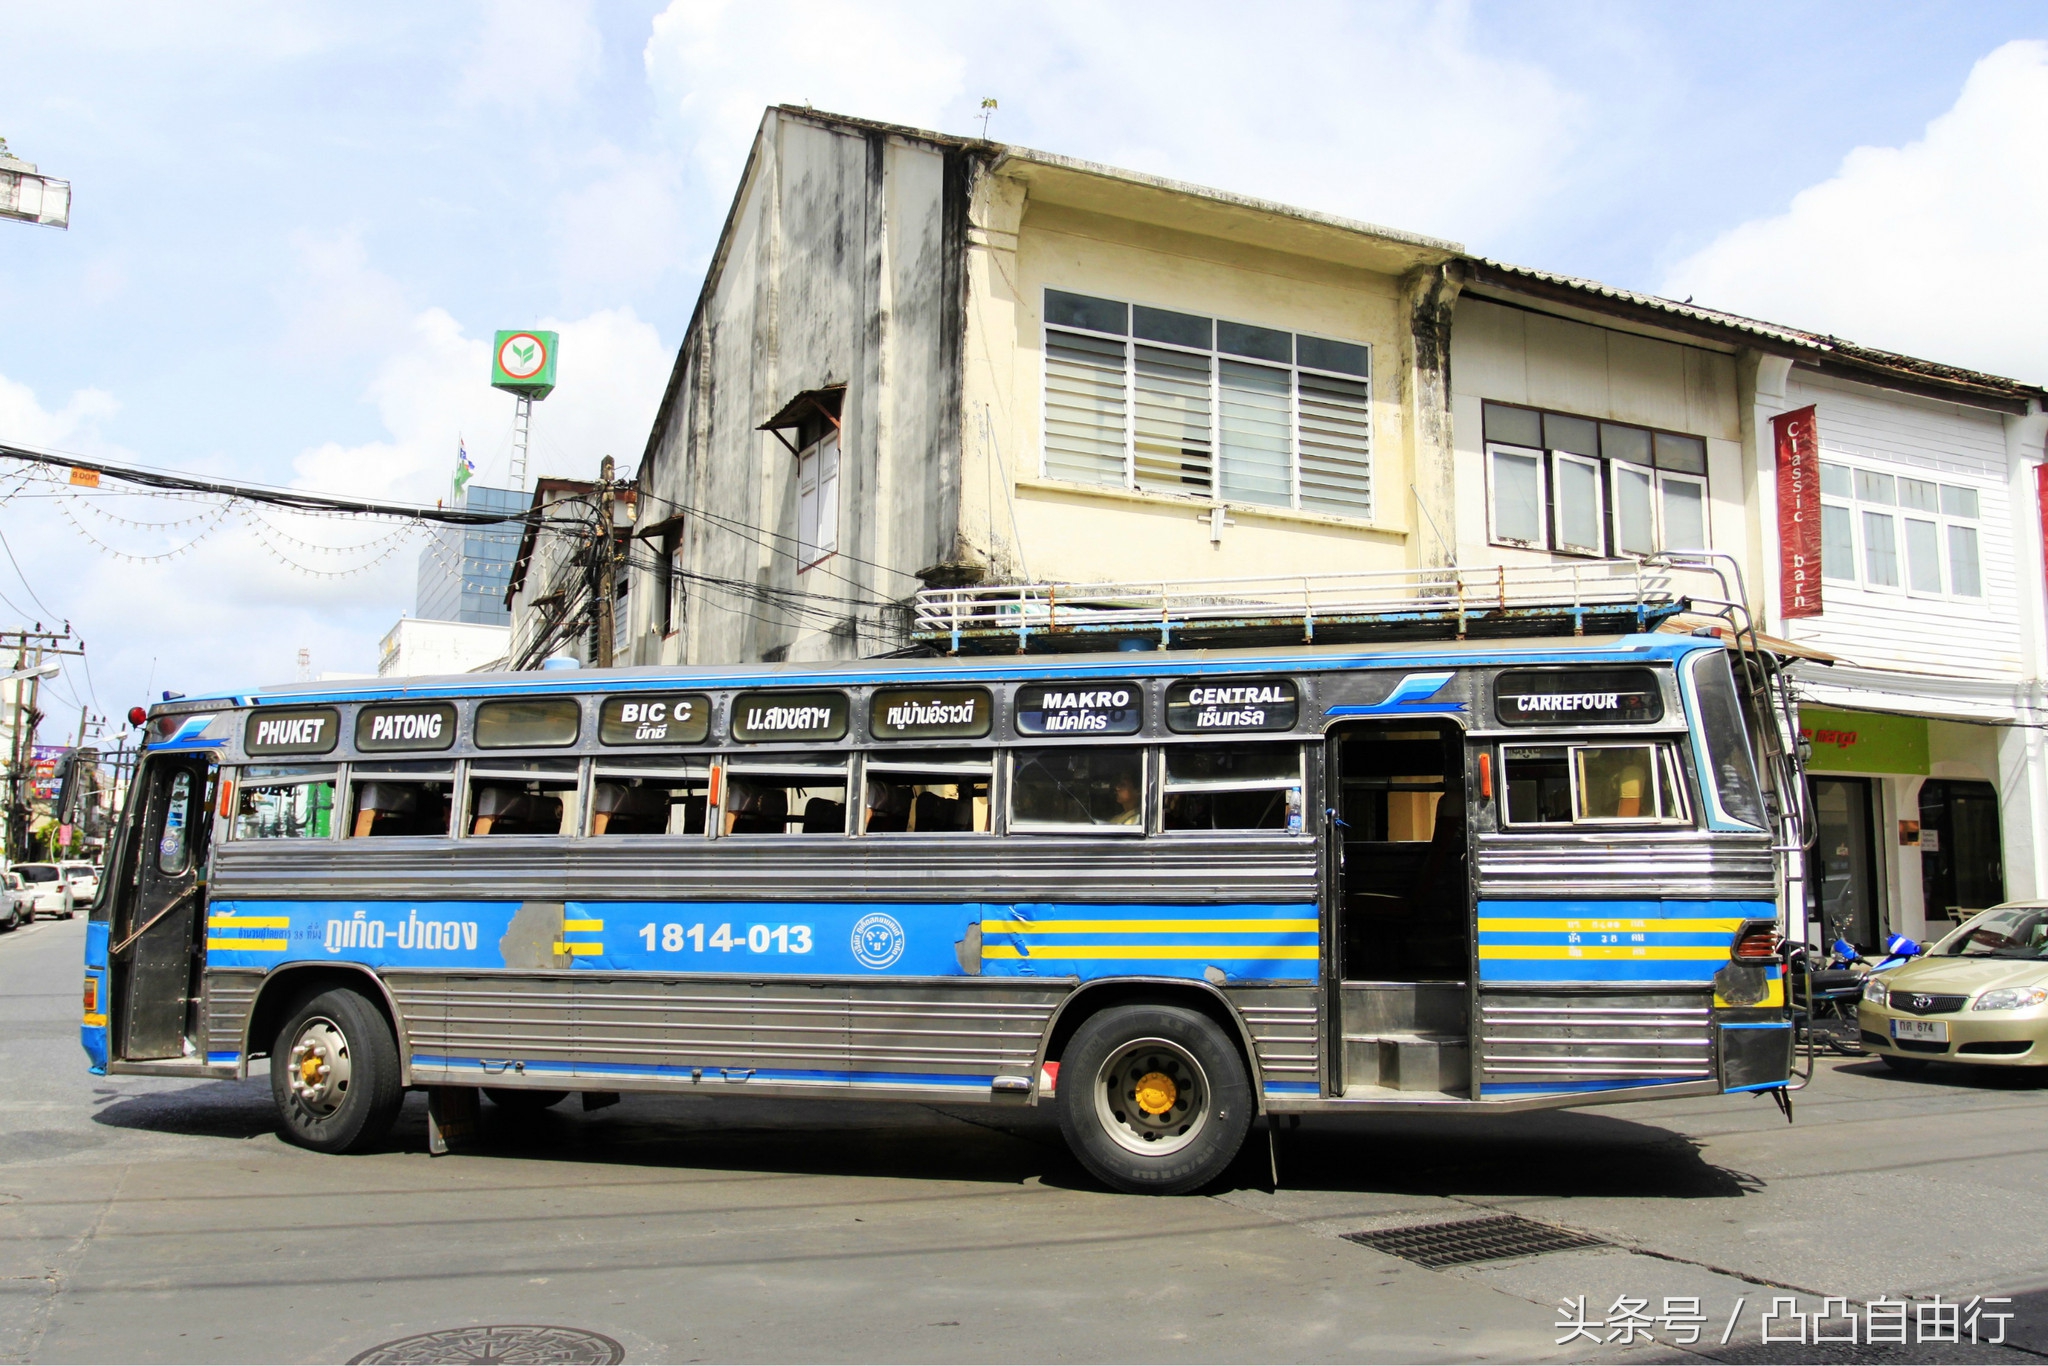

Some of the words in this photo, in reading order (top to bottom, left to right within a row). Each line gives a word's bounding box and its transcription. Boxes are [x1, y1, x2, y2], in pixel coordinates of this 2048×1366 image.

[1787, 421, 1803, 522] Classic
[1794, 555, 1806, 608] barn
[1042, 690, 1129, 709] MAKRO
[1189, 687, 1285, 705] CENTRAL
[1517, 693, 1618, 711] CARREFOUR
[621, 702, 666, 722] BIC
[673, 702, 692, 720] C
[746, 706, 831, 730] ม.สงขลาฯ
[256, 718, 325, 745] PHUKET
[371, 713, 442, 740] PATONG
[1815, 729, 1857, 749] mango
[323, 908, 478, 954] ภูเก็ต-ป่าตอง
[638, 922, 813, 954] 1814-013
[1917, 1022, 1933, 1032] 674
